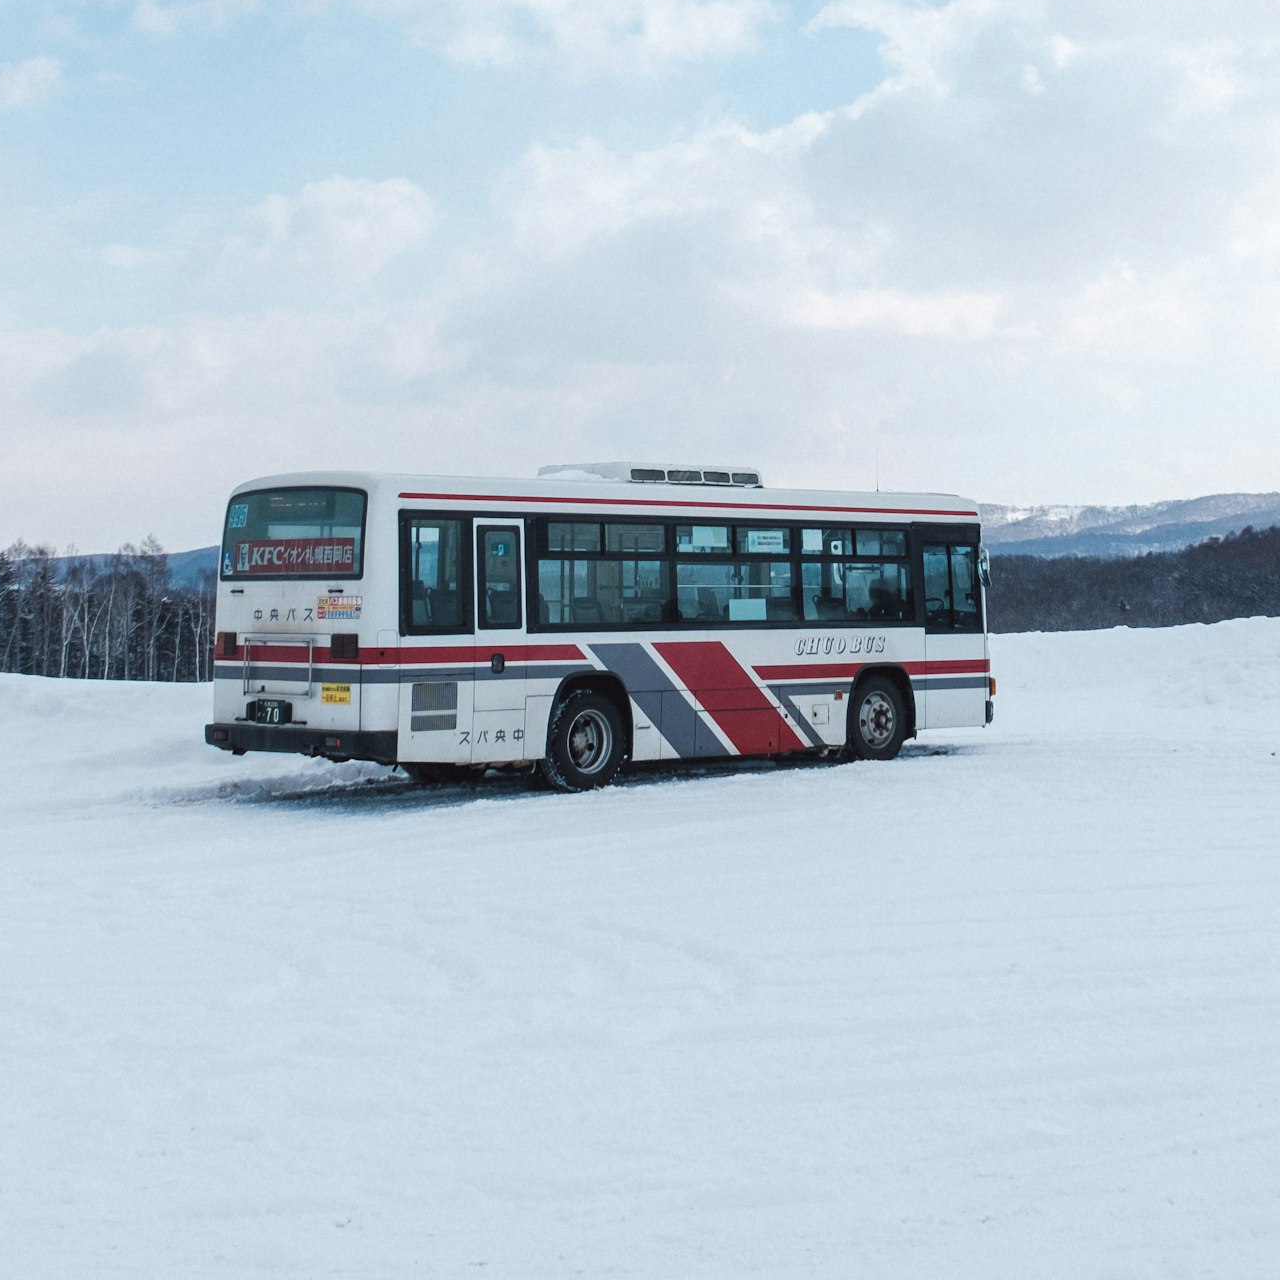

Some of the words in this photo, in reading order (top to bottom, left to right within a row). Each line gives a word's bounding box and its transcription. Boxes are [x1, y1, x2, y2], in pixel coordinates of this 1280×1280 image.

[254, 608, 314, 622] 中央バス
[794, 636, 846, 656] CHUO
[850, 635, 886, 654] BUS
[266, 707, 280, 723] 70
